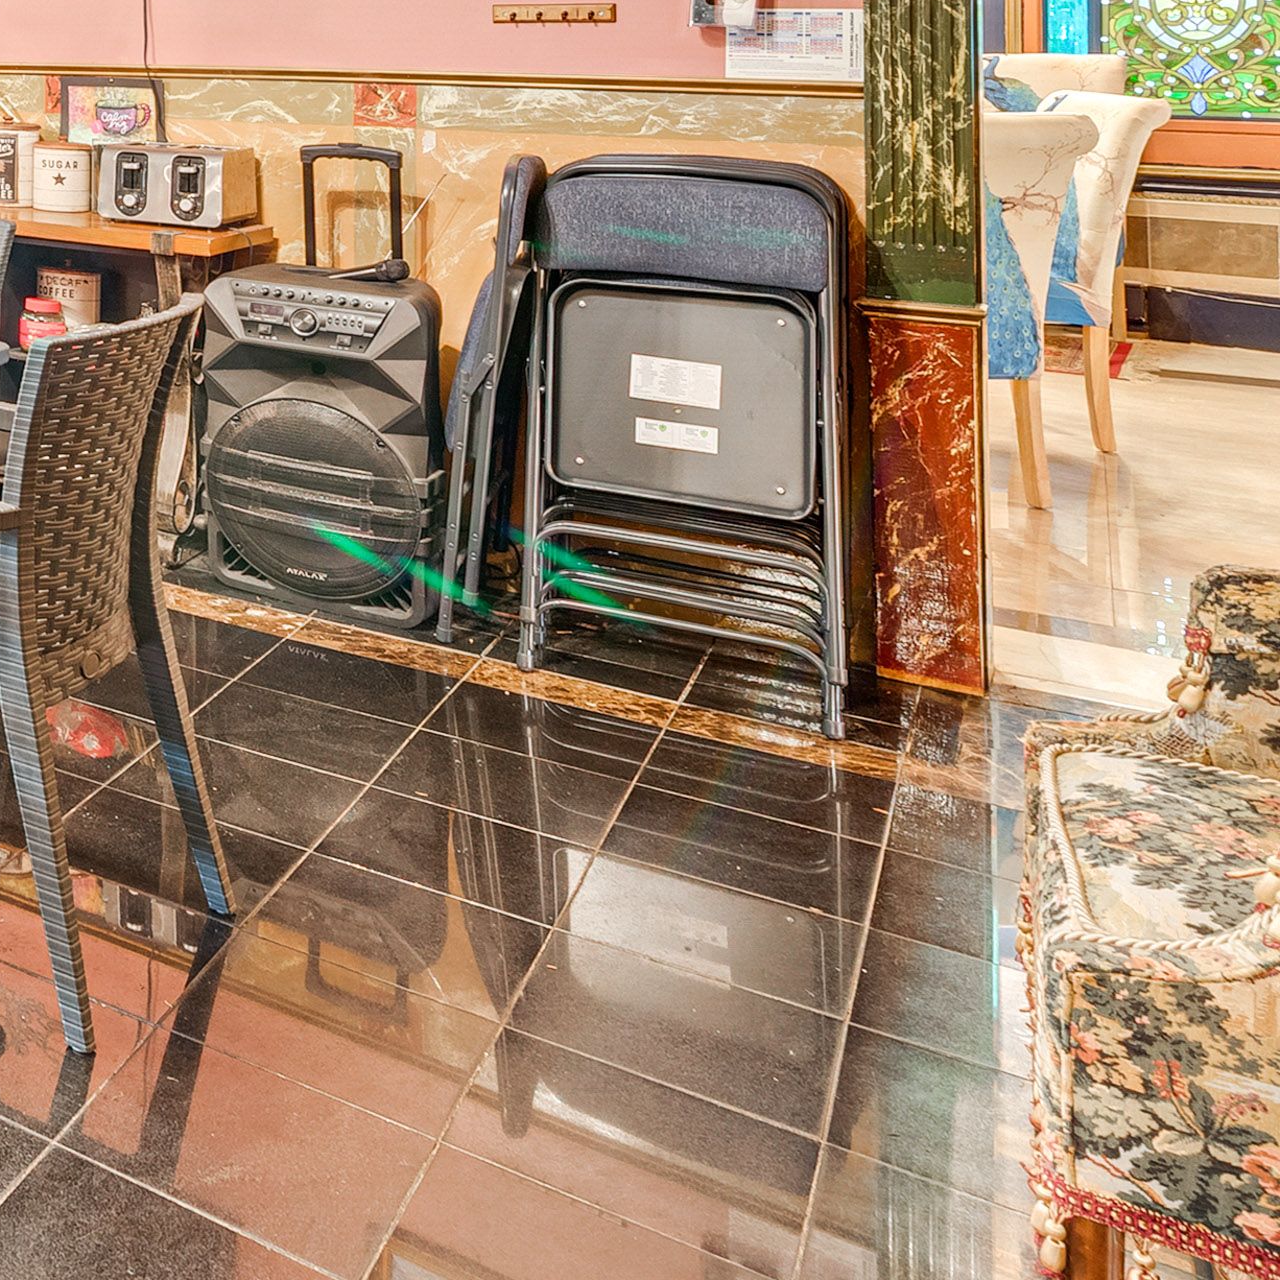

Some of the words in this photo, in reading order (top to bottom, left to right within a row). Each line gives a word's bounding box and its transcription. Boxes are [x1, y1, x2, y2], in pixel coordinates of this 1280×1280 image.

[42, 159, 80, 170] SUGAR
[45, 275, 82, 287] DECAF
[39, 285, 75, 299] COFFEE
